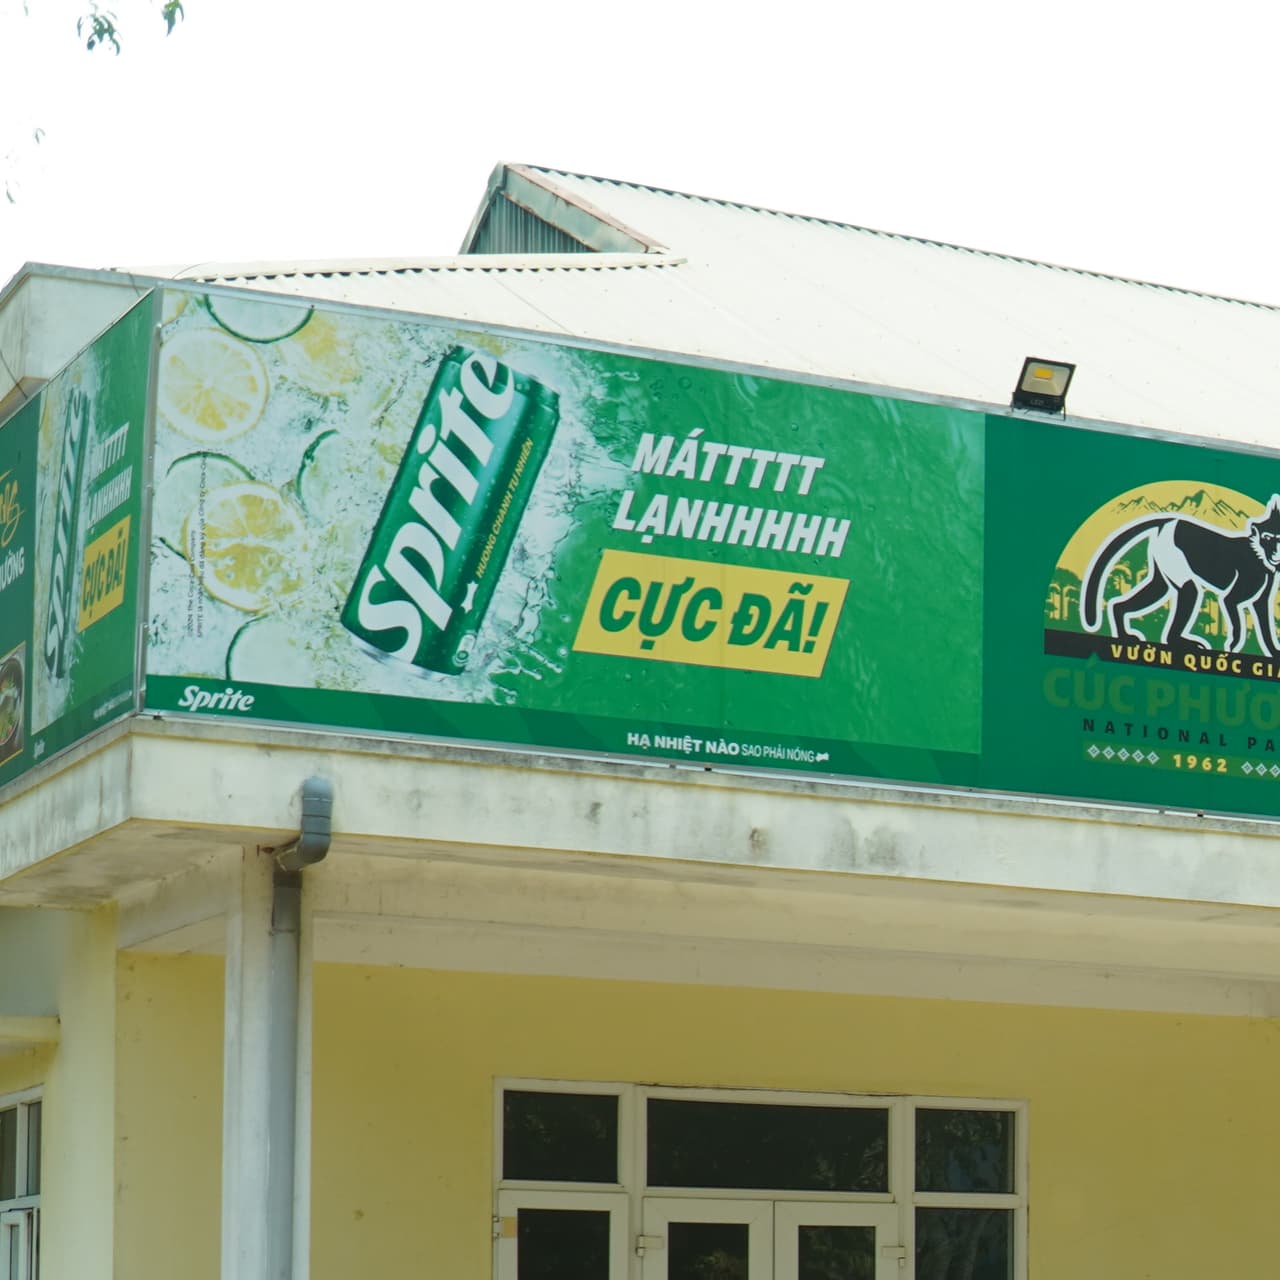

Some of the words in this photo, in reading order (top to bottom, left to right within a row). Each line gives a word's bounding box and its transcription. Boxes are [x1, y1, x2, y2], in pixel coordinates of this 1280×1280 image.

[631, 427, 827, 496] MÁTTTTT
[358, 351, 514, 665] Sprite
[612, 489, 852, 558] LẠNHHHHH
[598, 576, 723, 651] CỰC
[727, 581, 830, 654] ĐÃ!
[1110, 643, 1173, 665] VƯỜN
[1183, 652, 1242, 674] QUỐC
[178, 684, 255, 713] Sprite
[1042, 651, 1134, 713] CÚC
[627, 732, 651, 750] HẠ
[654, 734, 703, 754] NHIỆT
[705, 738, 740, 756] NÀO
[742, 744, 761, 758] SAO
[787, 747, 815, 763] NÓNG
[1083, 717, 1228, 748] NATIONAL
[1173, 753, 1228, 773] 1962
